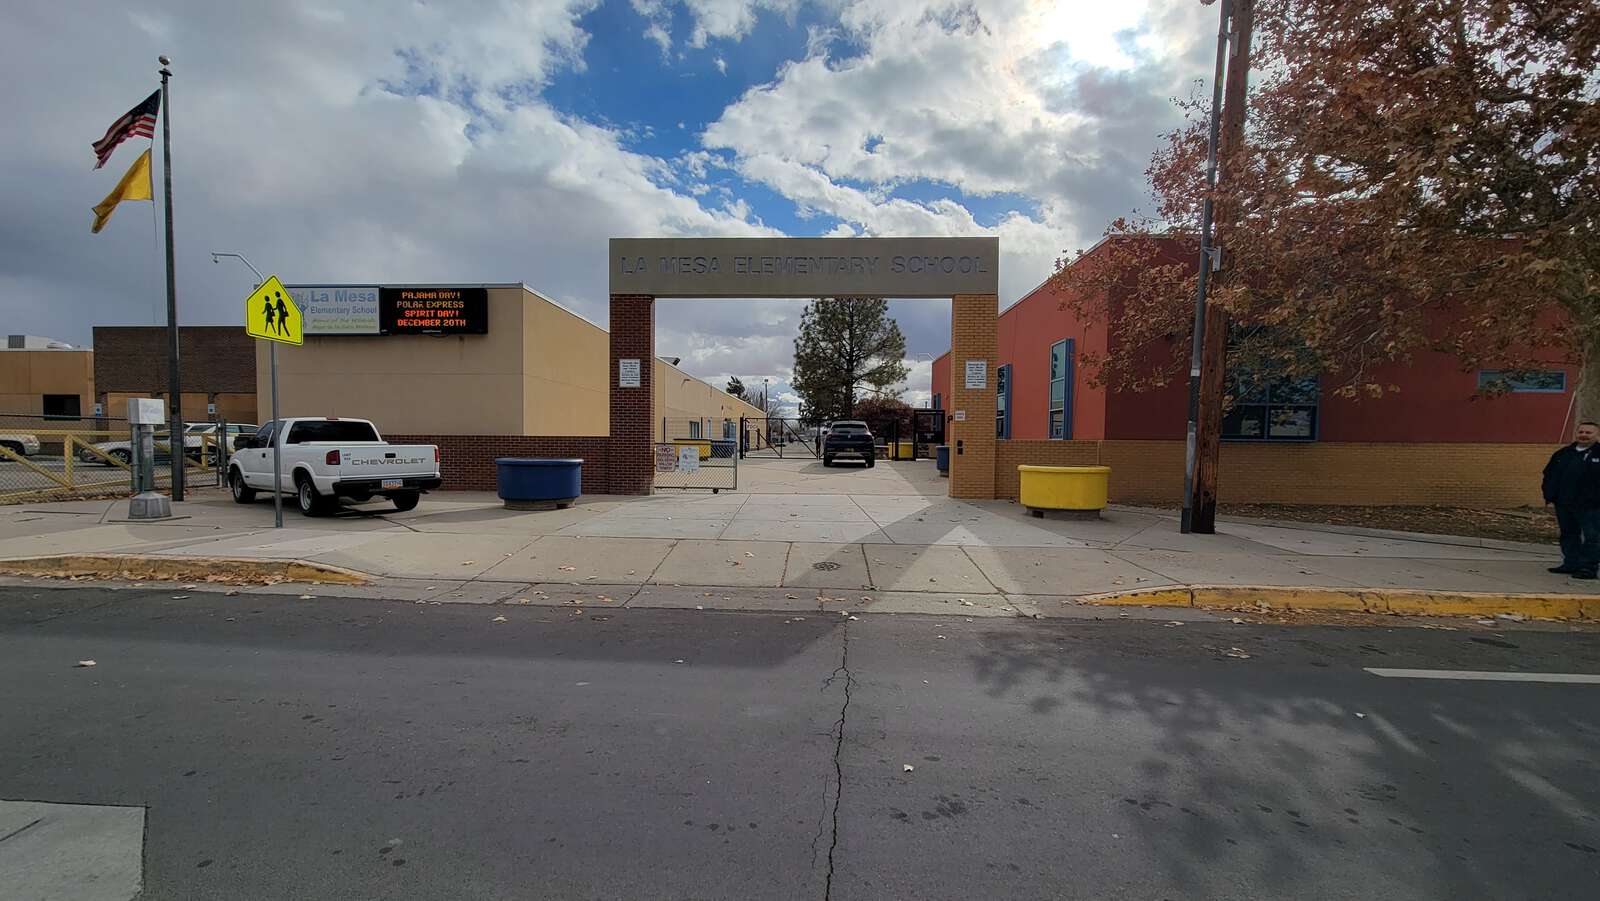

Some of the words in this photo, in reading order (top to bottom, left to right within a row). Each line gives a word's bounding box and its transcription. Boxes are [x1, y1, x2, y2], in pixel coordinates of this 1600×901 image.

[620, 255, 648, 274] LA
[659, 255, 721, 274] MESA
[732, 255, 879, 274] ELEMENTARY
[890, 255, 988, 273] SCHOOL
[310, 290, 330, 303] La
[334, 290, 377, 303] Mesa
[402, 291, 437, 299] PAJAMA
[438, 291, 461, 299] DAY!
[310, 305, 351, 315] Elementary
[352, 305, 377, 314] School
[351, 457, 426, 465] CHEVROLET
